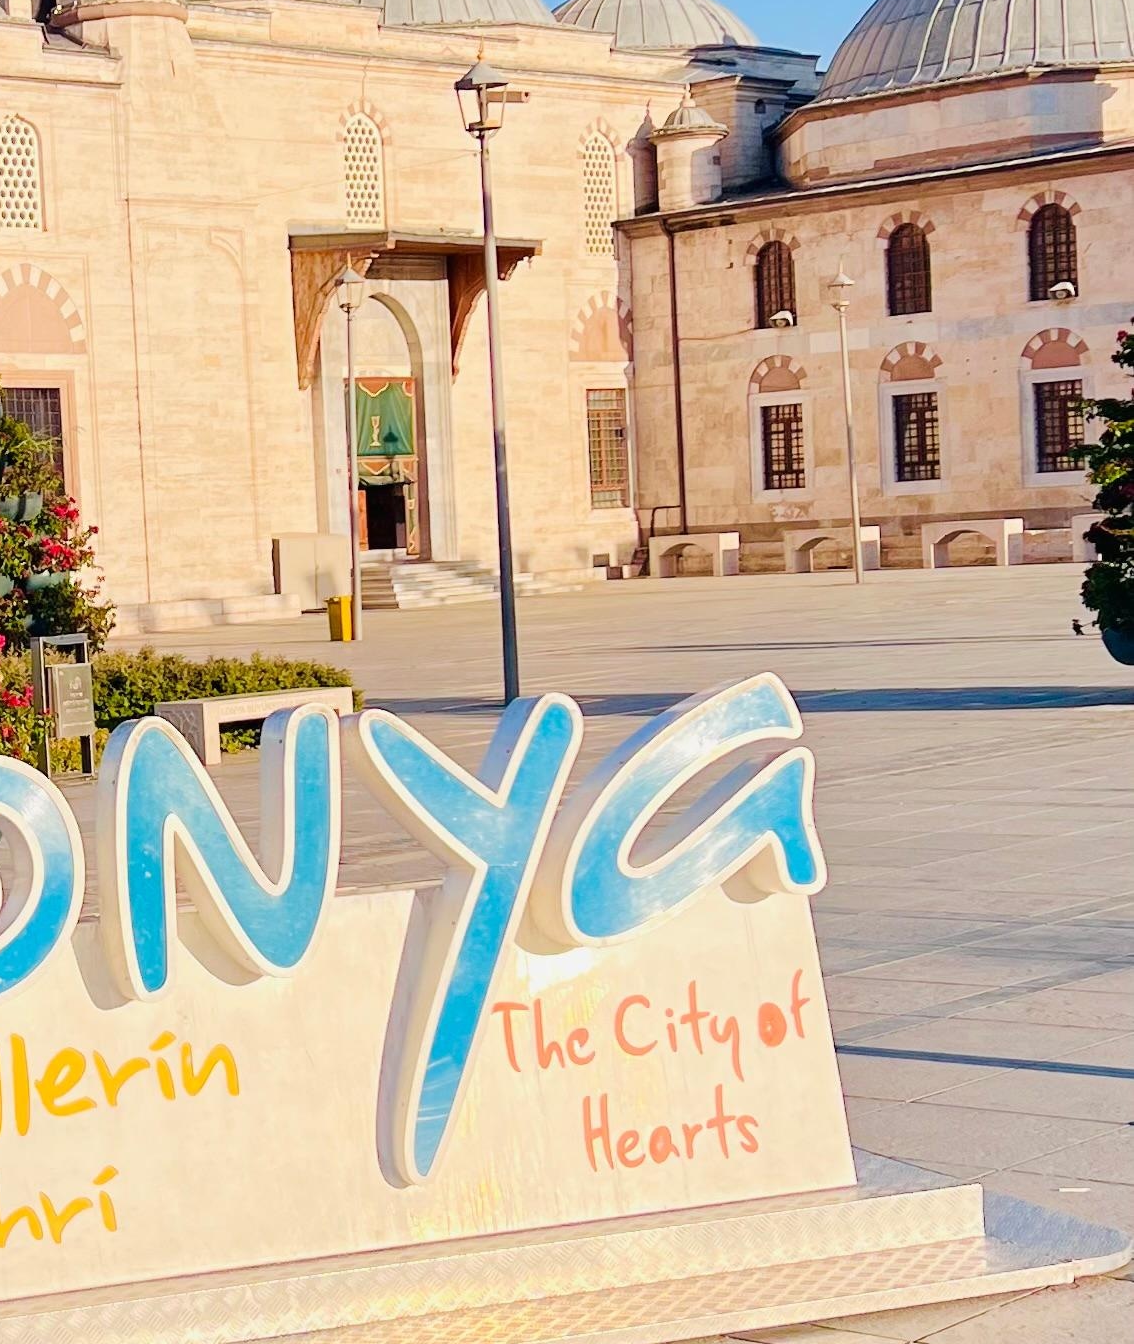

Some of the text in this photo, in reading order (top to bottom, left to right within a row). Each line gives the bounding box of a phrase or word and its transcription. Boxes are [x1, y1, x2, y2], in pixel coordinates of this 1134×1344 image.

[491, 968, 811, 1082] The City of
[582, 1083, 759, 1172] Hearts
